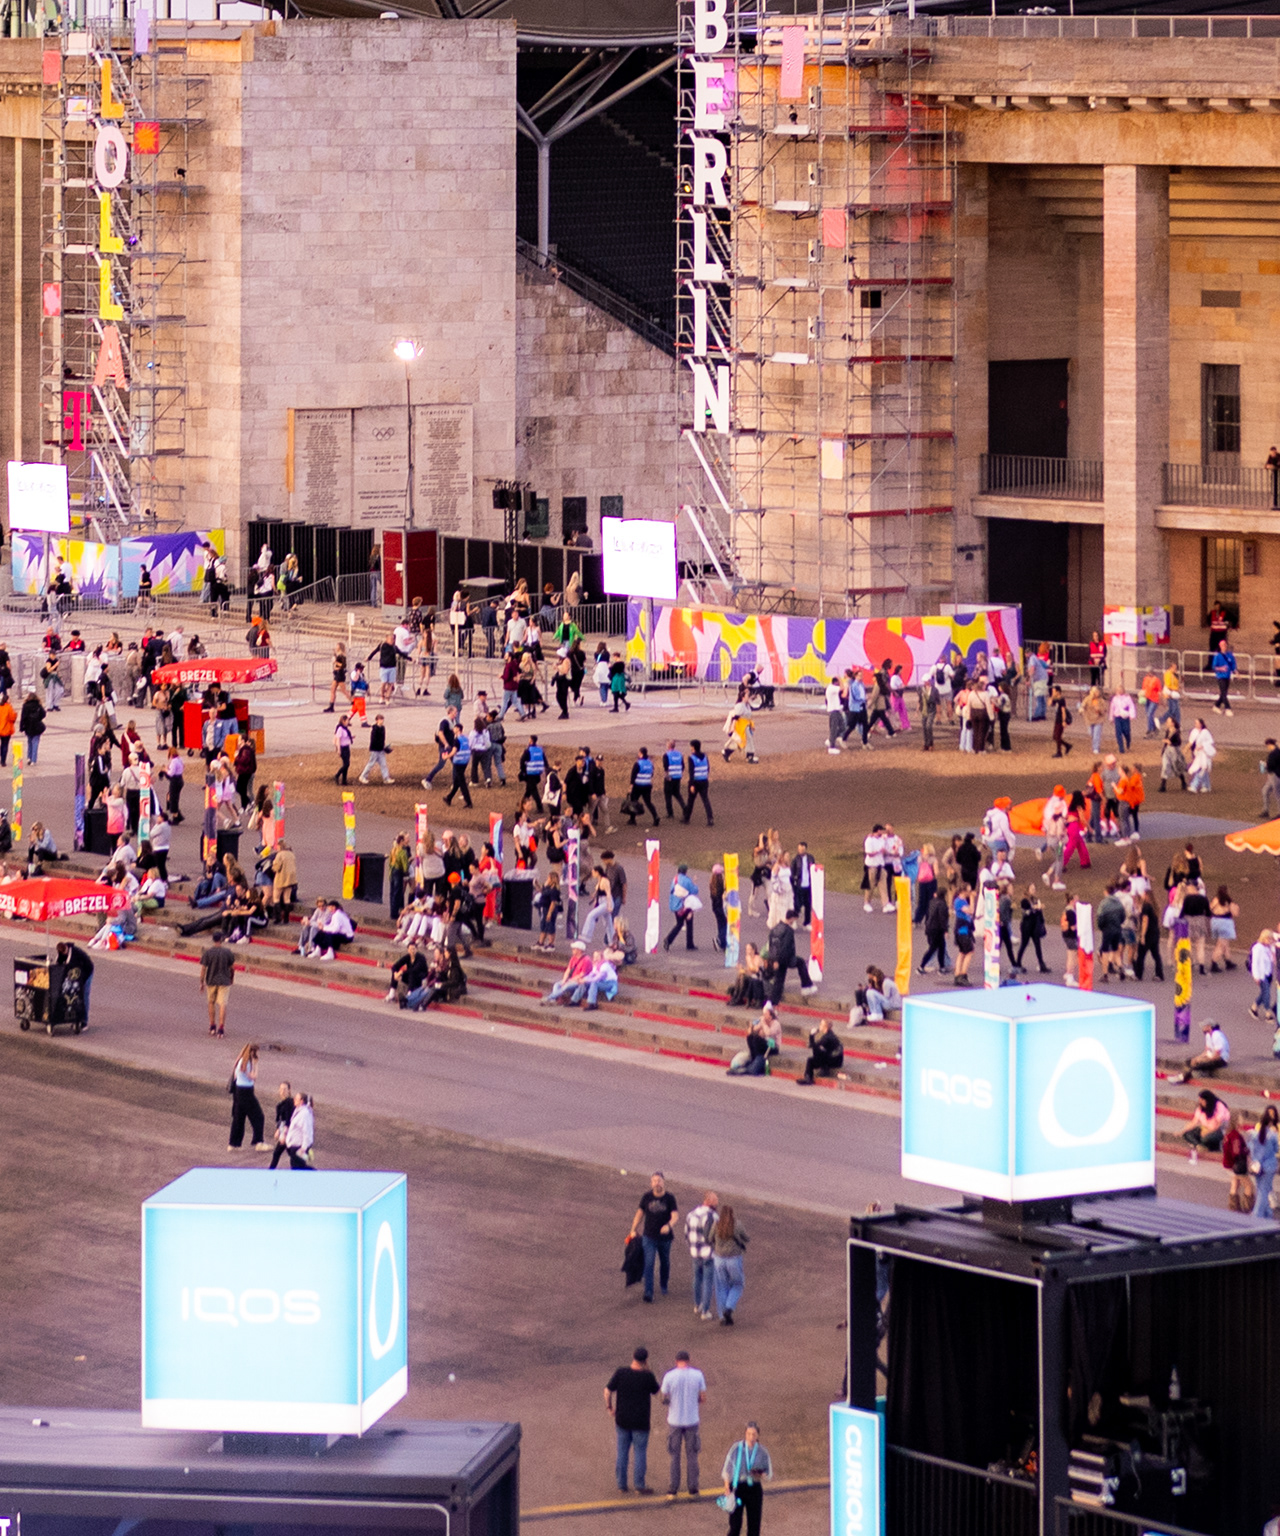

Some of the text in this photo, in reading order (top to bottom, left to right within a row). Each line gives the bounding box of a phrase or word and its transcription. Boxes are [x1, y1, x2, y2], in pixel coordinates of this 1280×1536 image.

[93, 58, 128, 388] LOLLA
[180, 669, 218, 682] BREZEL
[65, 895, 109, 914] BREZEL
[921, 1068, 993, 1110] IQOS
[182, 1286, 322, 1328] IQOS
